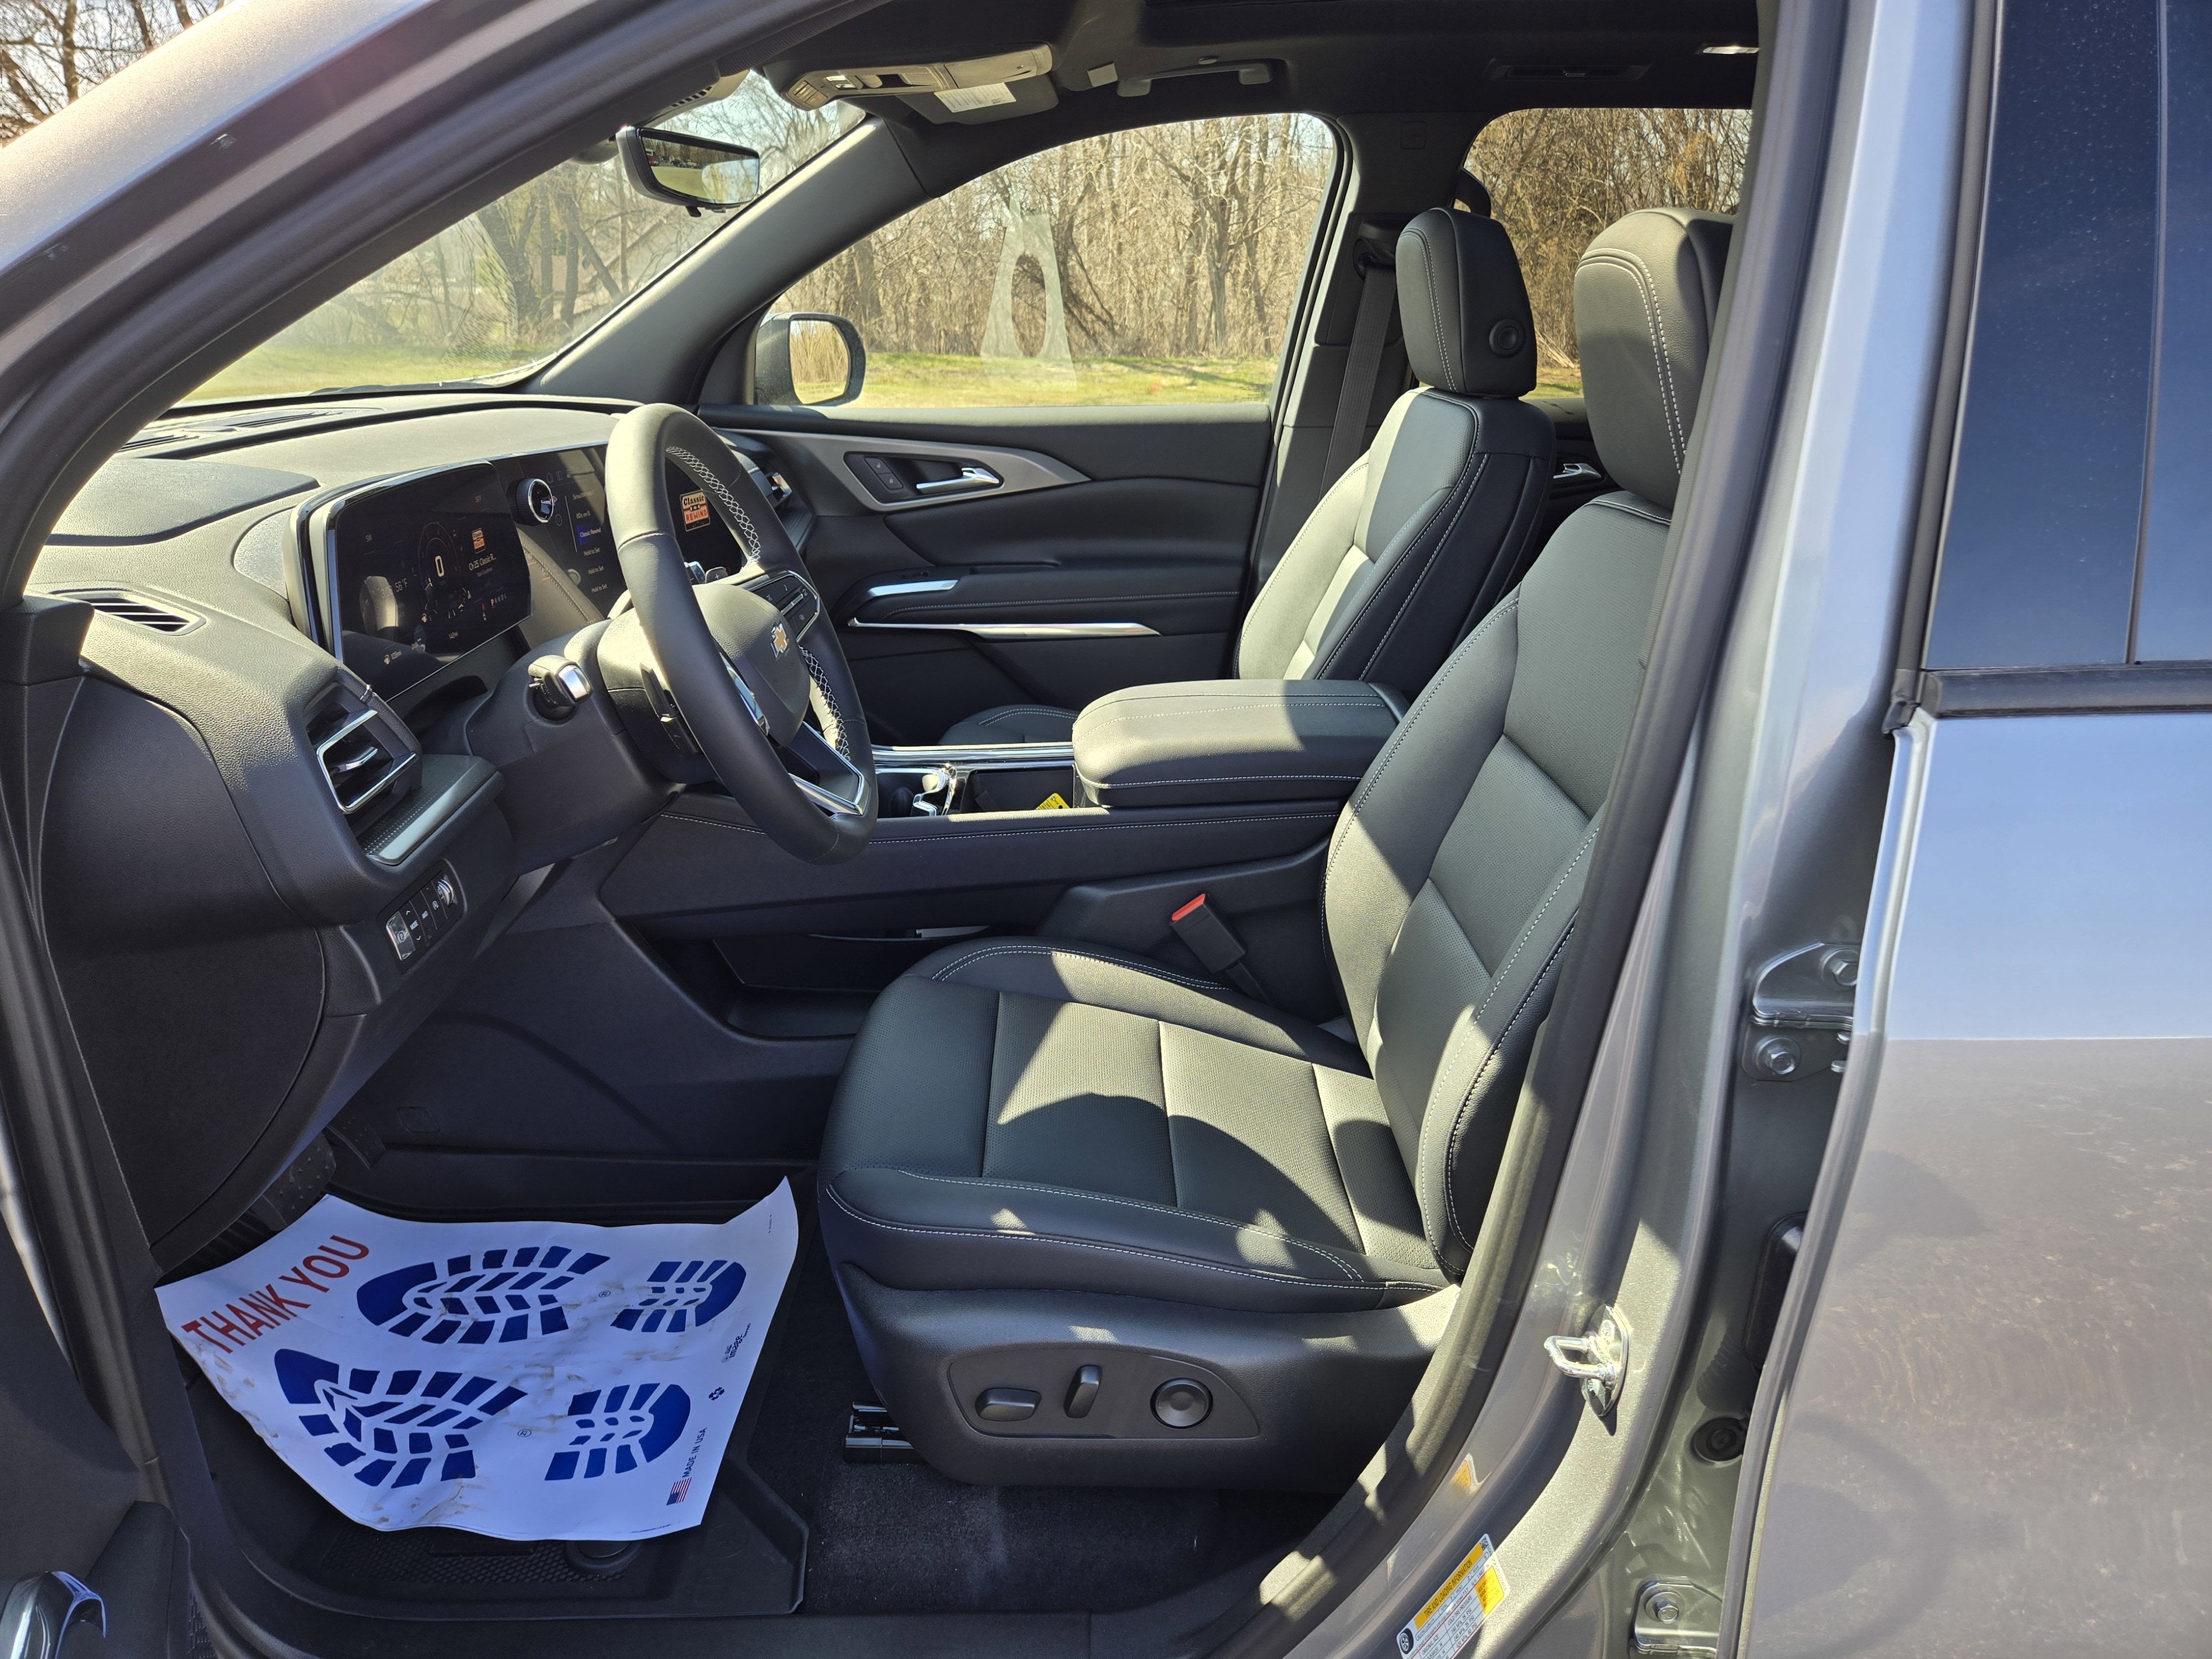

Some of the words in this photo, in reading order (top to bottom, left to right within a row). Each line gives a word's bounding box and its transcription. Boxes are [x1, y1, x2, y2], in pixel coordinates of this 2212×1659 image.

[684, 494, 705, 506] Classic
[686, 509, 707, 523] REWIND
[435, 555, 445, 577] 0
[181, 1284, 311, 1354] THANK
[278, 1235, 370, 1293] YOU
[695, 1427, 707, 1444] USA
[691, 1445, 701, 1454] IN
[682, 1455, 697, 1478] MADE
[1424, 1605, 1432, 1618] TIRE
[1438, 1582, 1452, 1602] LOADING
[1451, 1558, 1472, 1587] INFORMATION
